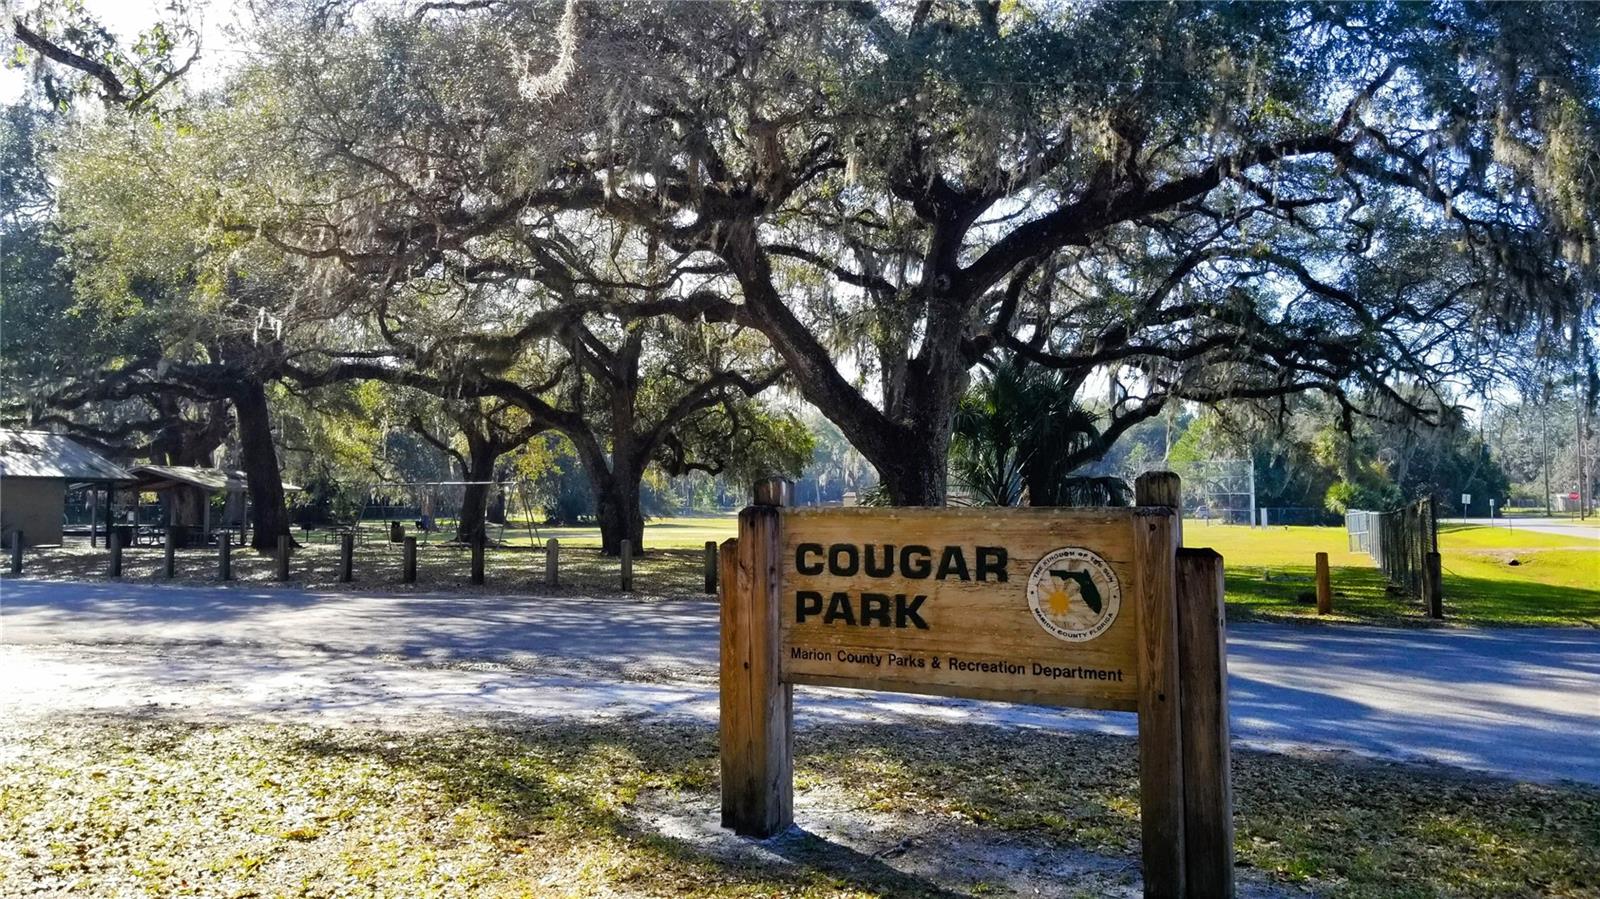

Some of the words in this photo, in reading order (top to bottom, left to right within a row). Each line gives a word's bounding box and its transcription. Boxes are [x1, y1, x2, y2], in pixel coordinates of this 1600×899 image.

[795, 542, 1009, 583] COUGAR
[795, 590, 930, 630] PARK
[1034, 607, 1056, 632] MARION
[1057, 629, 1088, 638] COUNTY
[790, 647, 832, 663] Marion
[836, 649, 883, 667] County
[888, 653, 926, 669] Parks
[931, 656, 942, 671] &
[949, 657, 1026, 676] Recreation
[1032, 662, 1124, 682] Department
